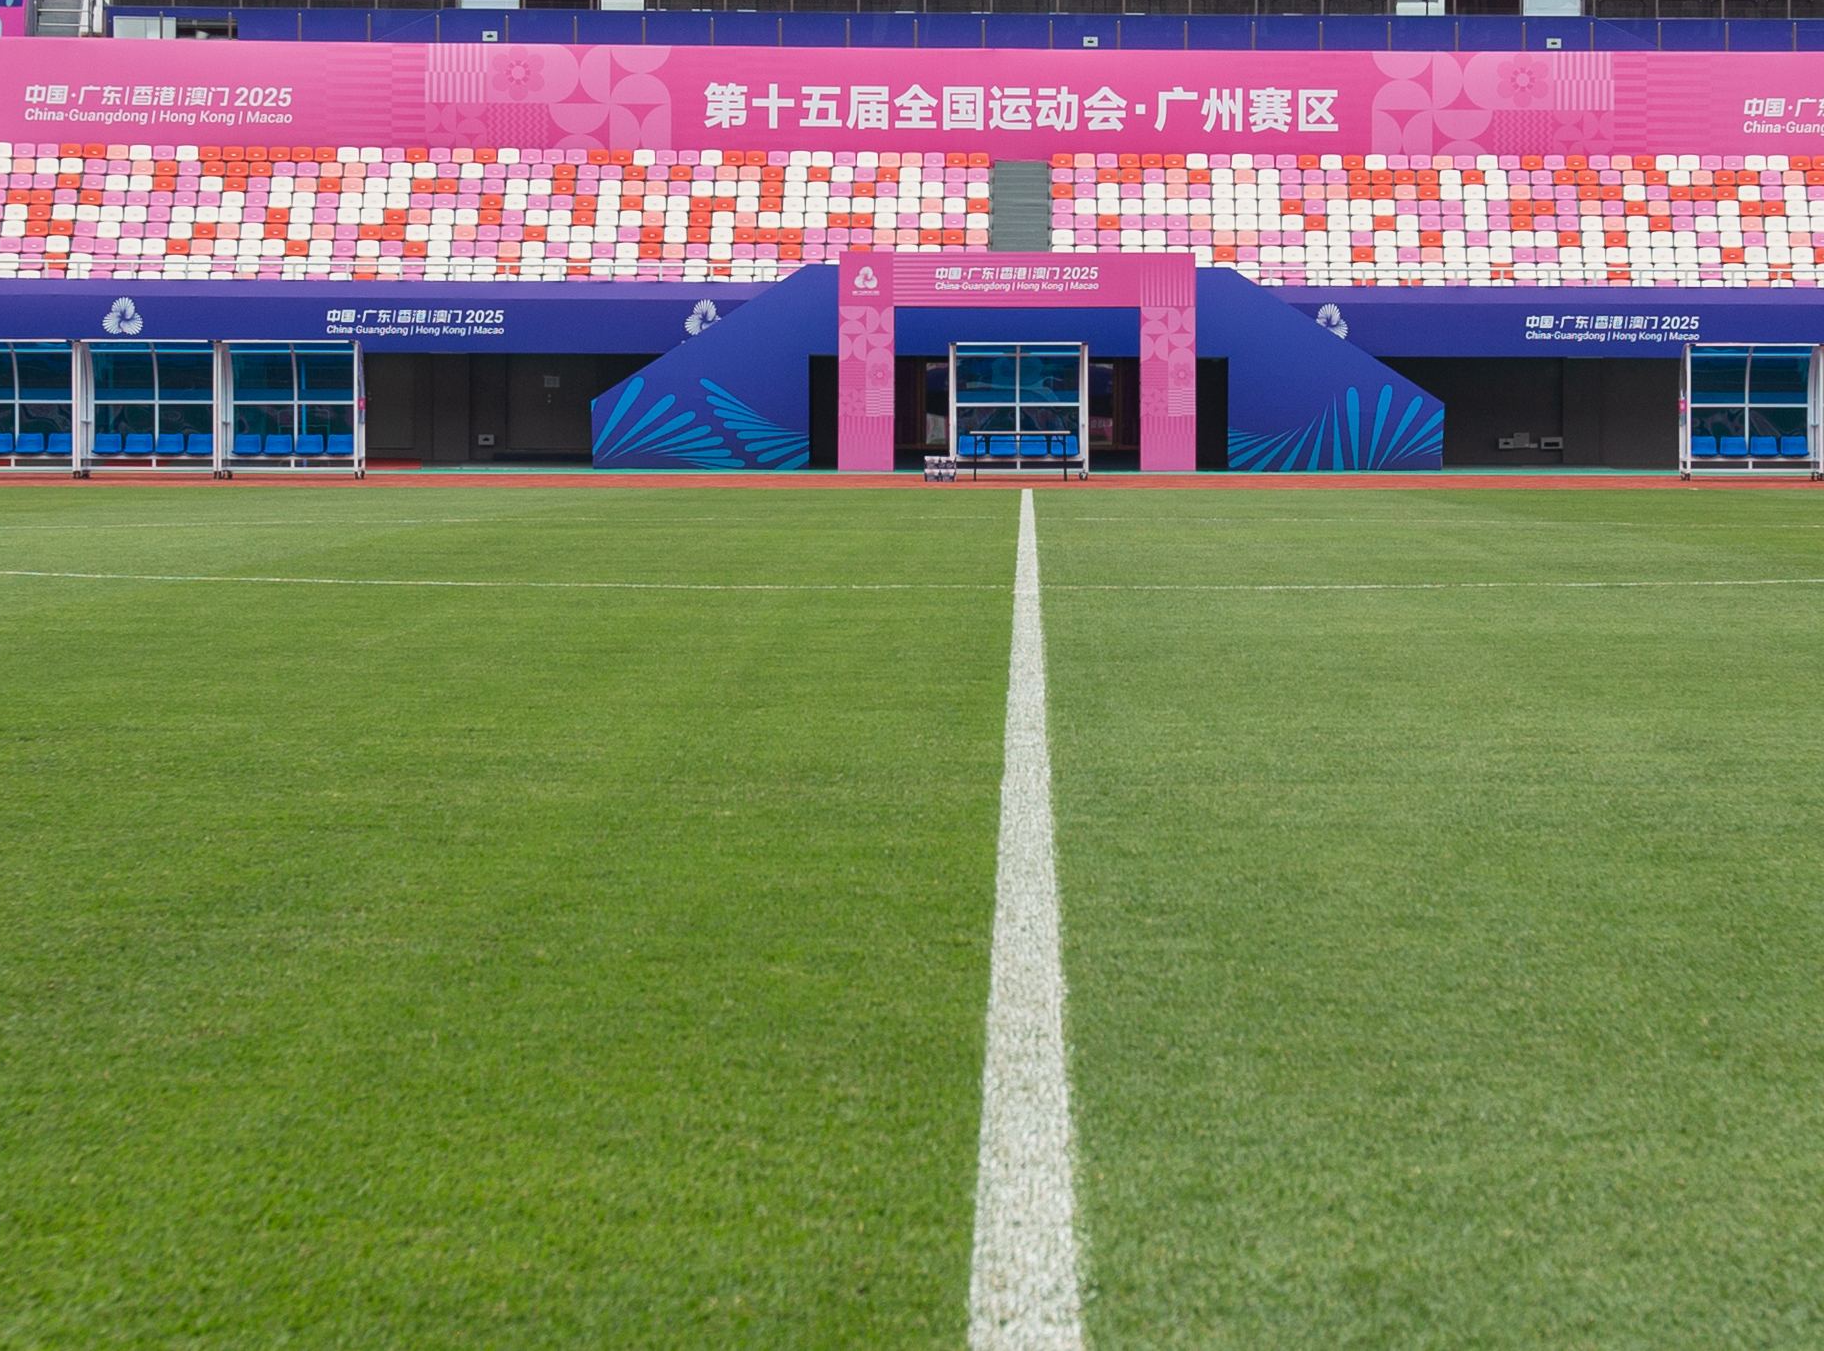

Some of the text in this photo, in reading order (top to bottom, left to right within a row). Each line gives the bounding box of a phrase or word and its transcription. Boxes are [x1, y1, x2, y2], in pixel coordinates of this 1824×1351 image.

[24, 85, 293, 107] 中国·广东|香港|澳门 2025
[703, 82, 1340, 133] 第十五届全国运动会·广州赛区
[24, 108, 293, 125] China·Guangdong Hong Kong Macao
[1062, 267, 1099, 279] 2025
[1016, 282, 1040, 291] Hong
[1041, 282, 1064, 291] Kong
[464, 310, 505, 323] 2025
[1660, 316, 1700, 329] 2025
[415, 326, 441, 335] Hong
[441, 326, 467, 336] Kong
[472, 326, 505, 334] Macao
[1612, 332, 1637, 342] Hong
[1638, 332, 1663, 342] Kong
[1668, 332, 1700, 340] Macao
